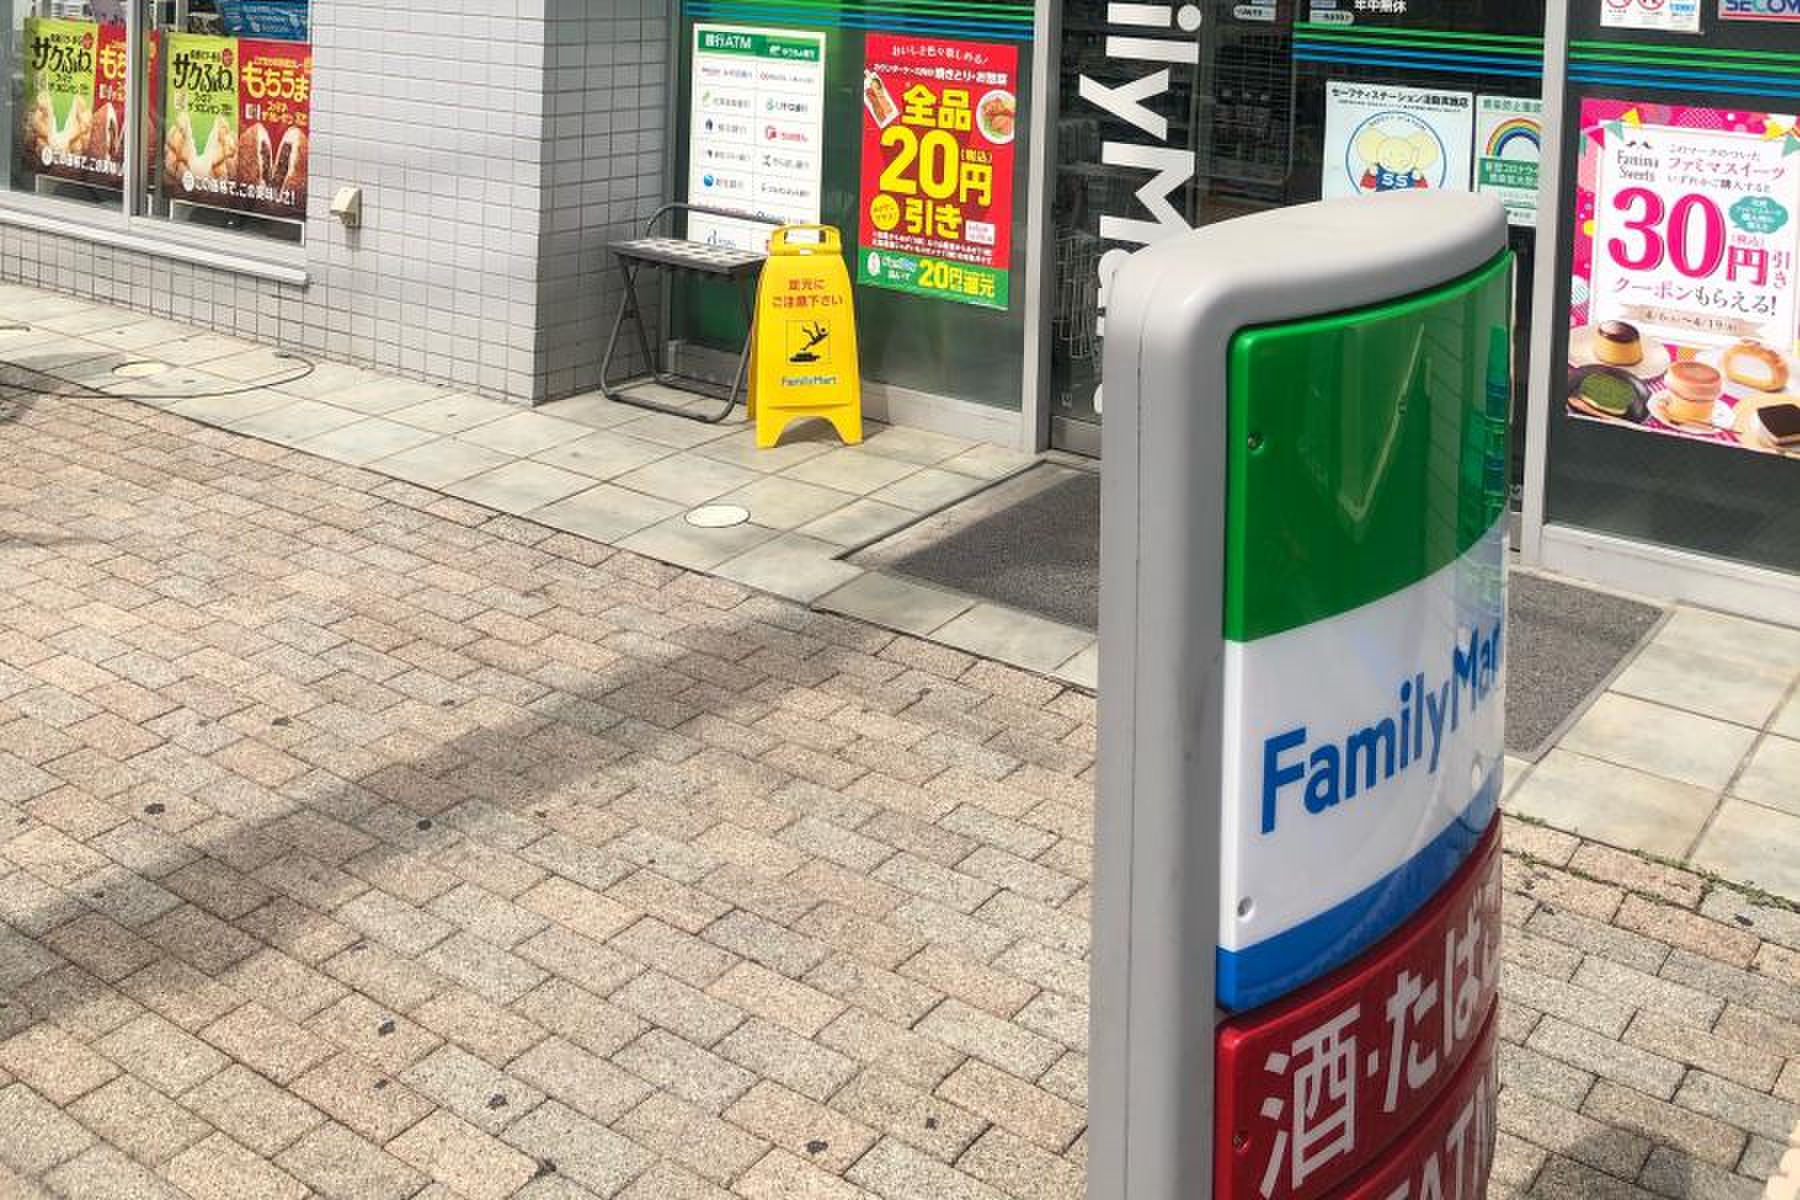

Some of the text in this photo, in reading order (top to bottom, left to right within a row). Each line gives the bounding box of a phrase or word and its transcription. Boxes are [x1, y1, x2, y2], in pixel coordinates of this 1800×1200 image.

[1353, 0, 1408, 14] 年中無休
[899, 82, 973, 133] 全品
[879, 125, 993, 208] 20円
[1381, 174, 1409, 187] SS
[1668, 157, 1786, 182] ファミマスイーツ
[904, 197, 963, 240] 引き
[1607, 186, 1770, 287] 30円
[1614, 275, 1779, 317] クーポンもらえる!
[781, 375, 838, 387] FamilyMart
[1259, 622, 1500, 835] FamilyMar
